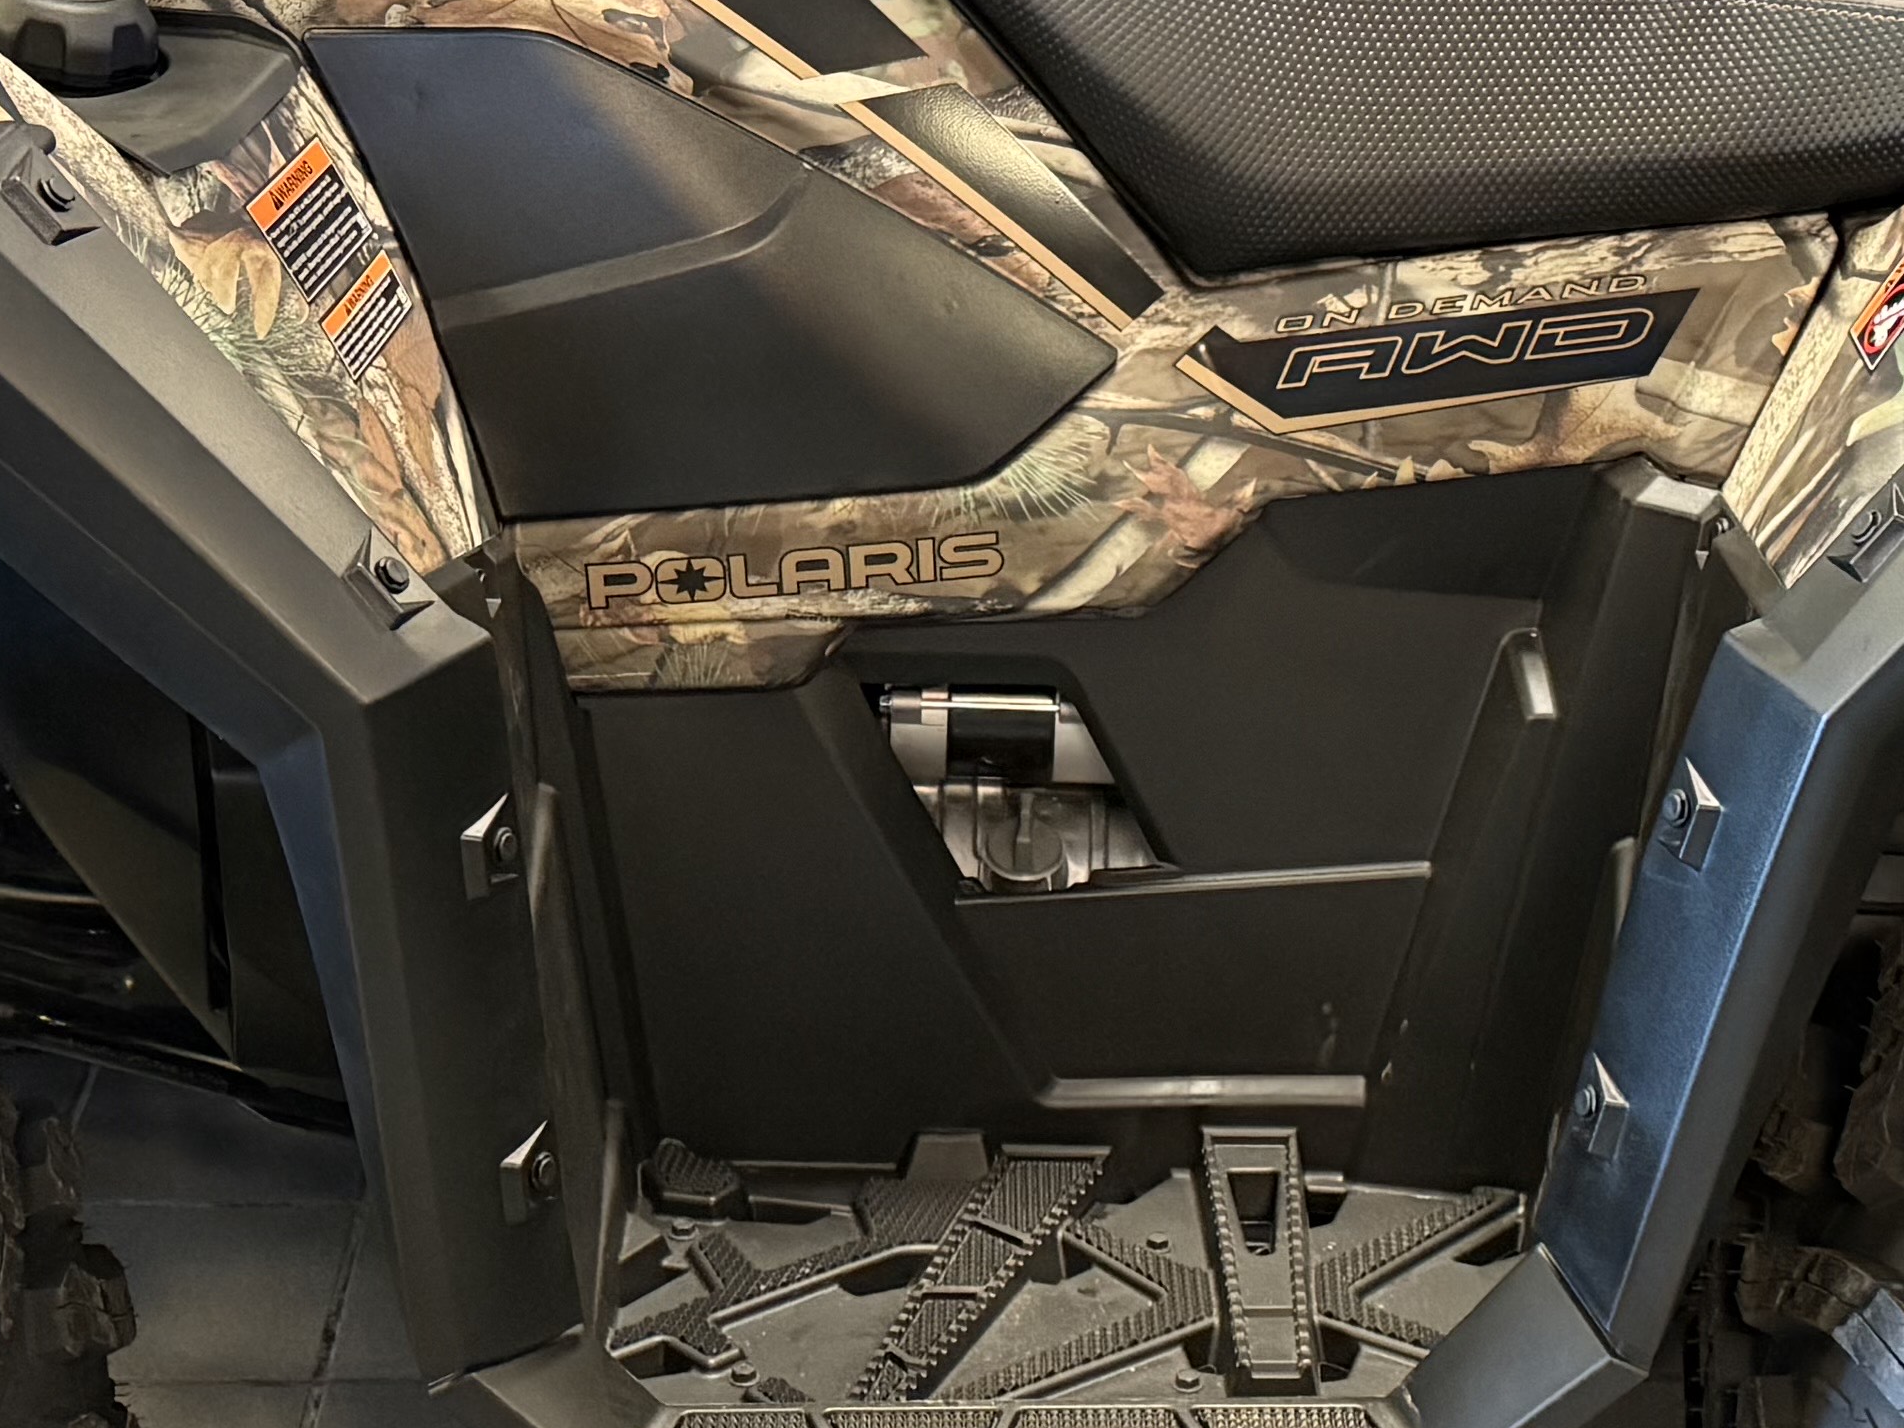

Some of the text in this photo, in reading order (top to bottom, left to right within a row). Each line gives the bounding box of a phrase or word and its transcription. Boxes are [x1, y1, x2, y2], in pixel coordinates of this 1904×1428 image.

[278, 160, 313, 205] WARNING
[1275, 274, 1648, 334] ON DEMAND
[1276, 306, 1655, 390] AWD
[584, 530, 1006, 611] POLARIS
